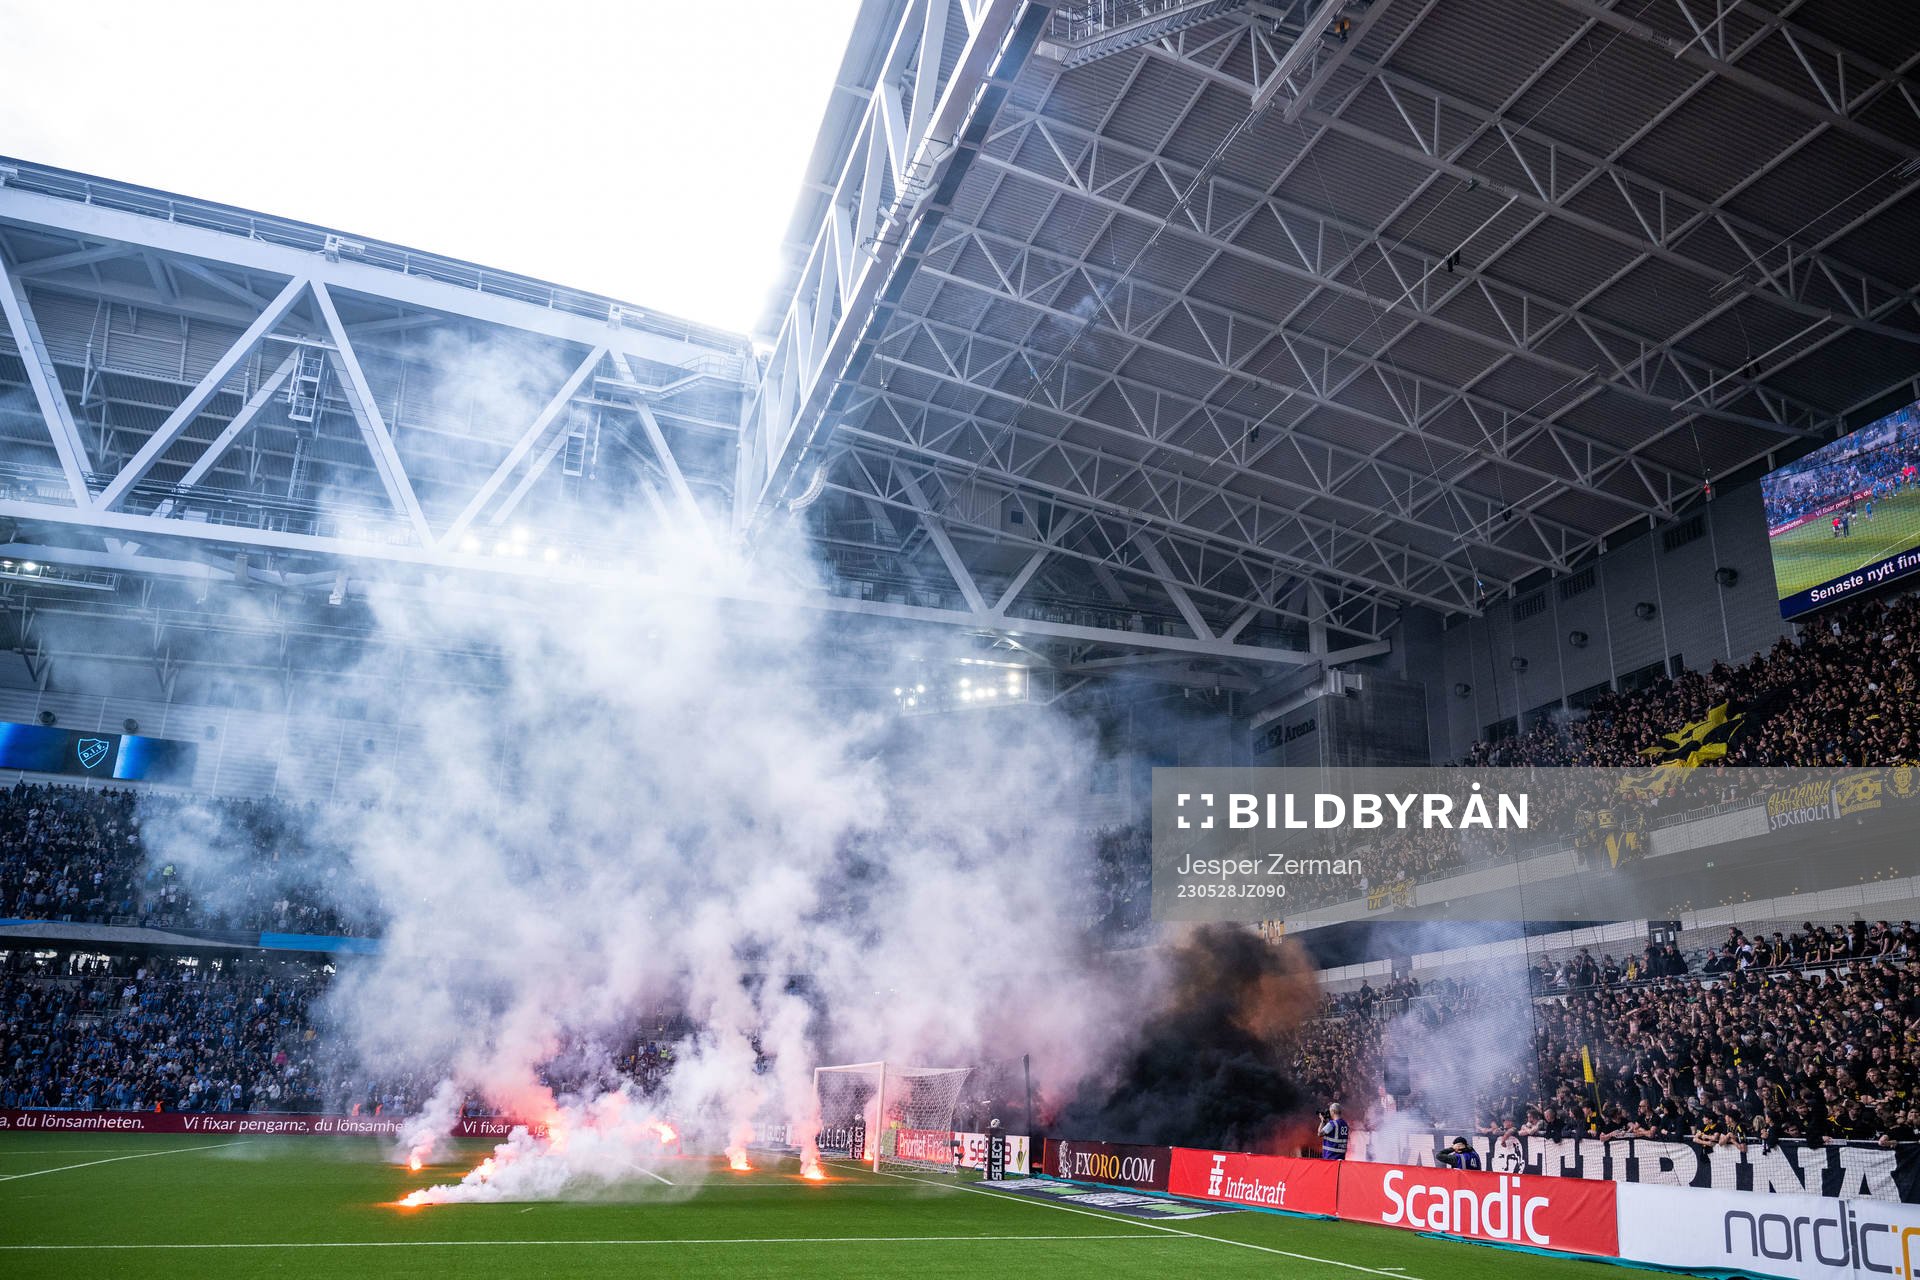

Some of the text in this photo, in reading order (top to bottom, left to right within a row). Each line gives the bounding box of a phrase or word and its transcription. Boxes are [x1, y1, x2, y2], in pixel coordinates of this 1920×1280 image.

[1810, 552, 1920, 603] Senaste nytt fin
[1284, 718, 1317, 743] Arena
[1770, 804, 1831, 831] STOCKHOLM
[16, 1113, 37, 1128] du
[41, 1113, 145, 1129] lönsamheten.
[183, 1116, 199, 1130] Vi
[202, 1116, 236, 1130] fixar
[314, 1118, 333, 1131] du
[336, 1118, 407, 1132] lönsamhe
[463, 1121, 477, 1134] Vi
[480, 1121, 511, 1134] fixar
[1340, 1126, 1348, 1136] 82
[854, 1126, 865, 1159] SELECT
[991, 1136, 1003, 1181] SELECT
[1075, 1154, 1156, 1184] FXORO.COM
[1224, 1176, 1286, 1205] Infrakraft
[1382, 1169, 1549, 1245] Scandic
